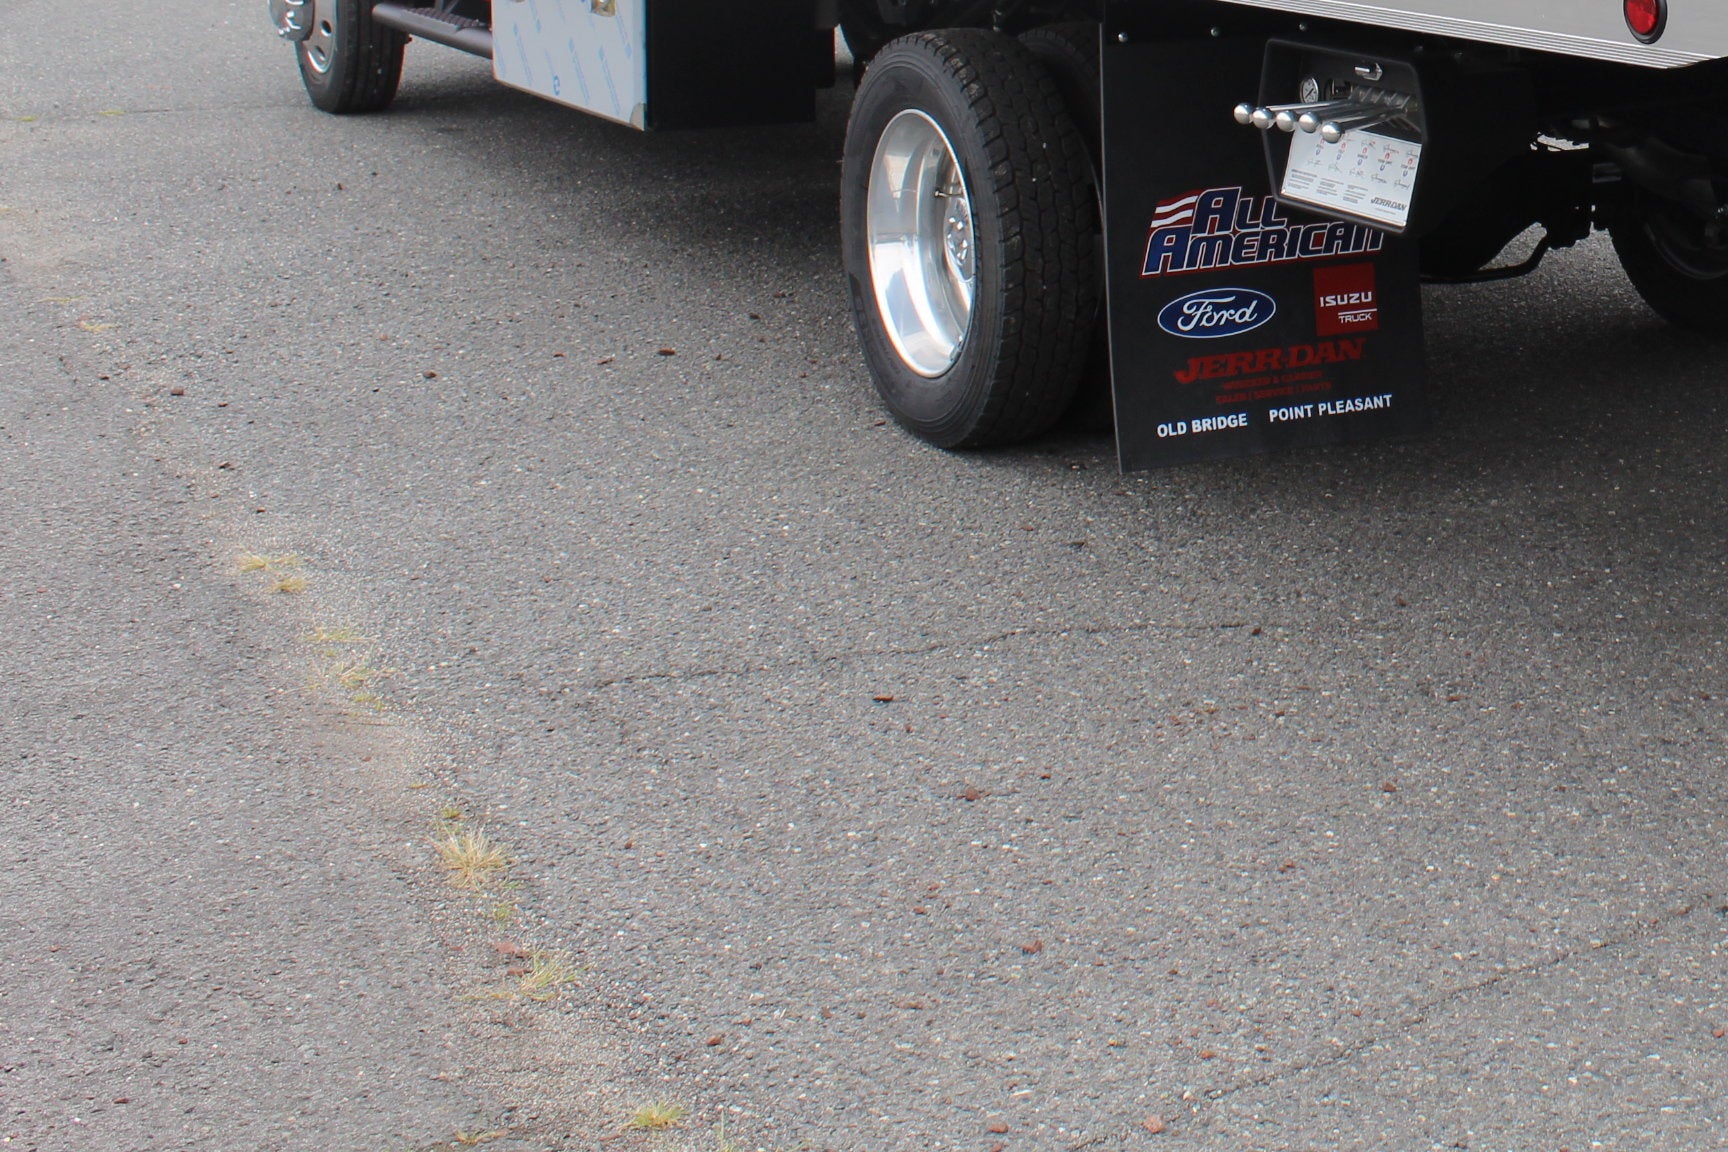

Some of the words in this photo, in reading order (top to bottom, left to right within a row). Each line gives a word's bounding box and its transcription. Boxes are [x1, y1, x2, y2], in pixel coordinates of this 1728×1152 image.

[1191, 185, 1288, 236] ALL
[1142, 221, 1386, 276] AMERICAN
[1176, 295, 1259, 332] Ford
[1319, 290, 1373, 309] ISUZU
[1337, 313, 1373, 325] TRUCK
[1156, 421, 1188, 438] OLD
[1190, 412, 1248, 434] BRIDGE
[1268, 404, 1315, 423] POINT
[1317, 393, 1393, 416] PLEASANT
